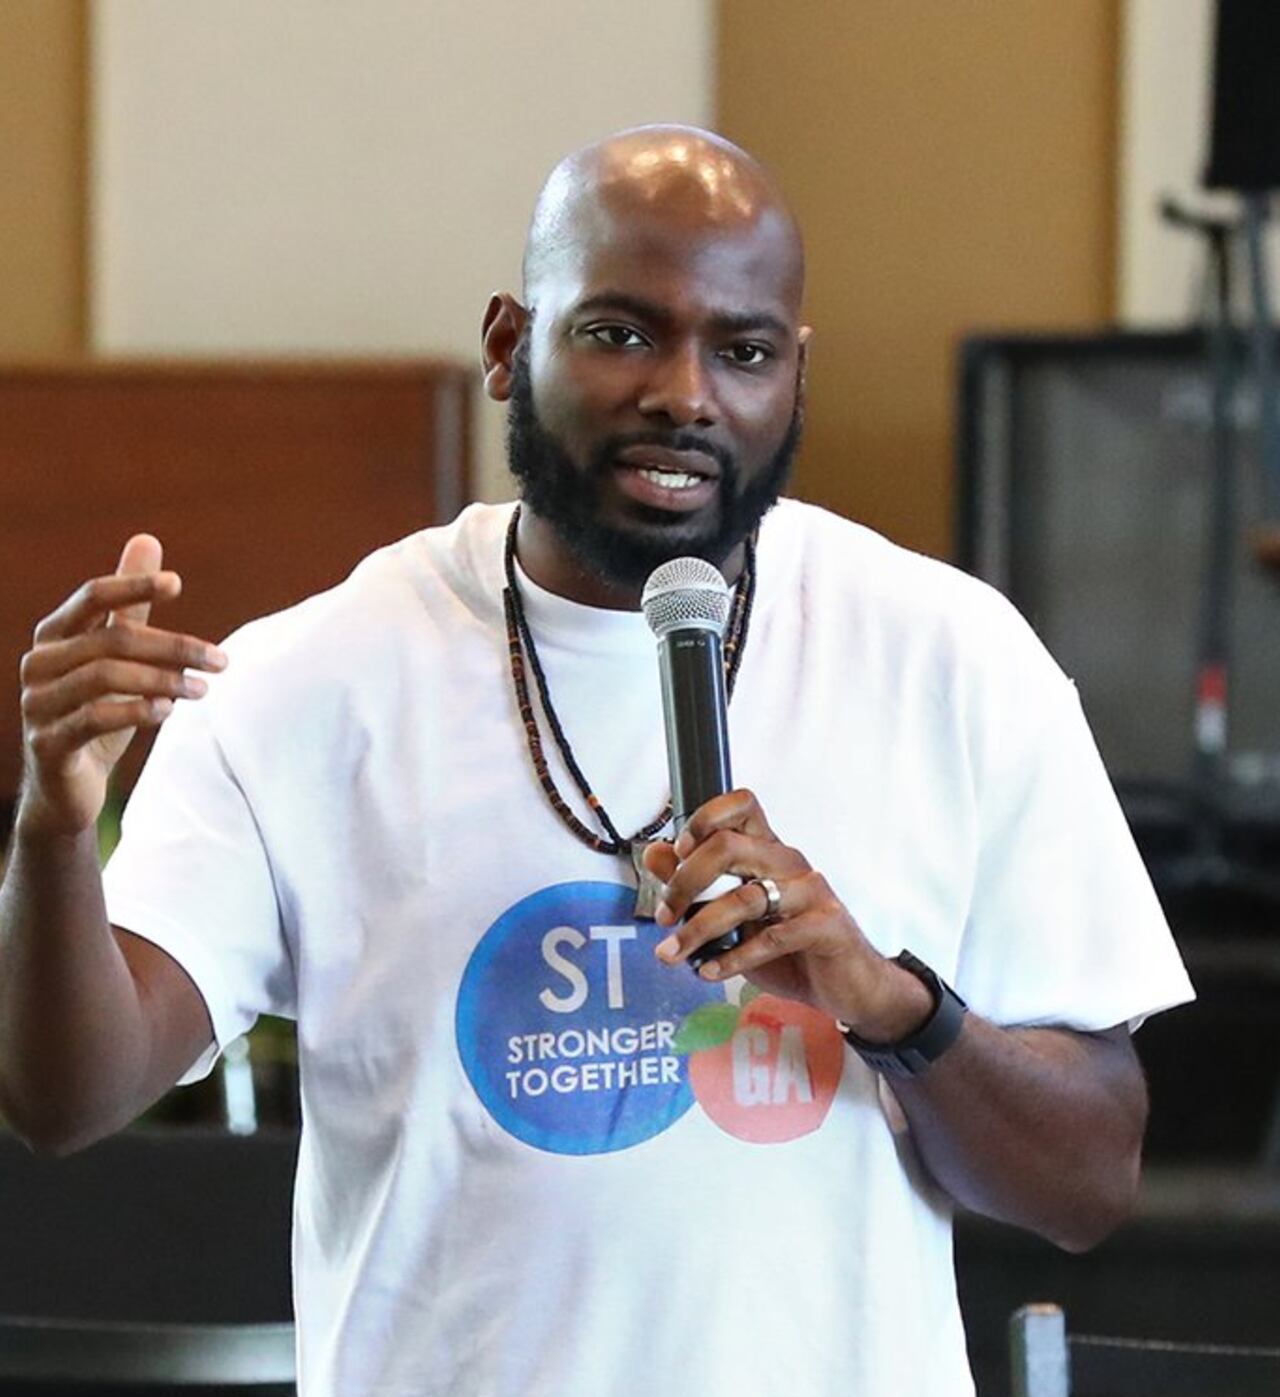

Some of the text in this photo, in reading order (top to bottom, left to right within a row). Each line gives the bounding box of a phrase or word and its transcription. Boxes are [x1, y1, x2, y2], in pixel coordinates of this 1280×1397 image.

[539, 925, 637, 1013] ST
[507, 1020, 677, 1064] STRONGER
[732, 1027, 816, 1106] GA
[506, 1057, 680, 1098] TOGETHER
